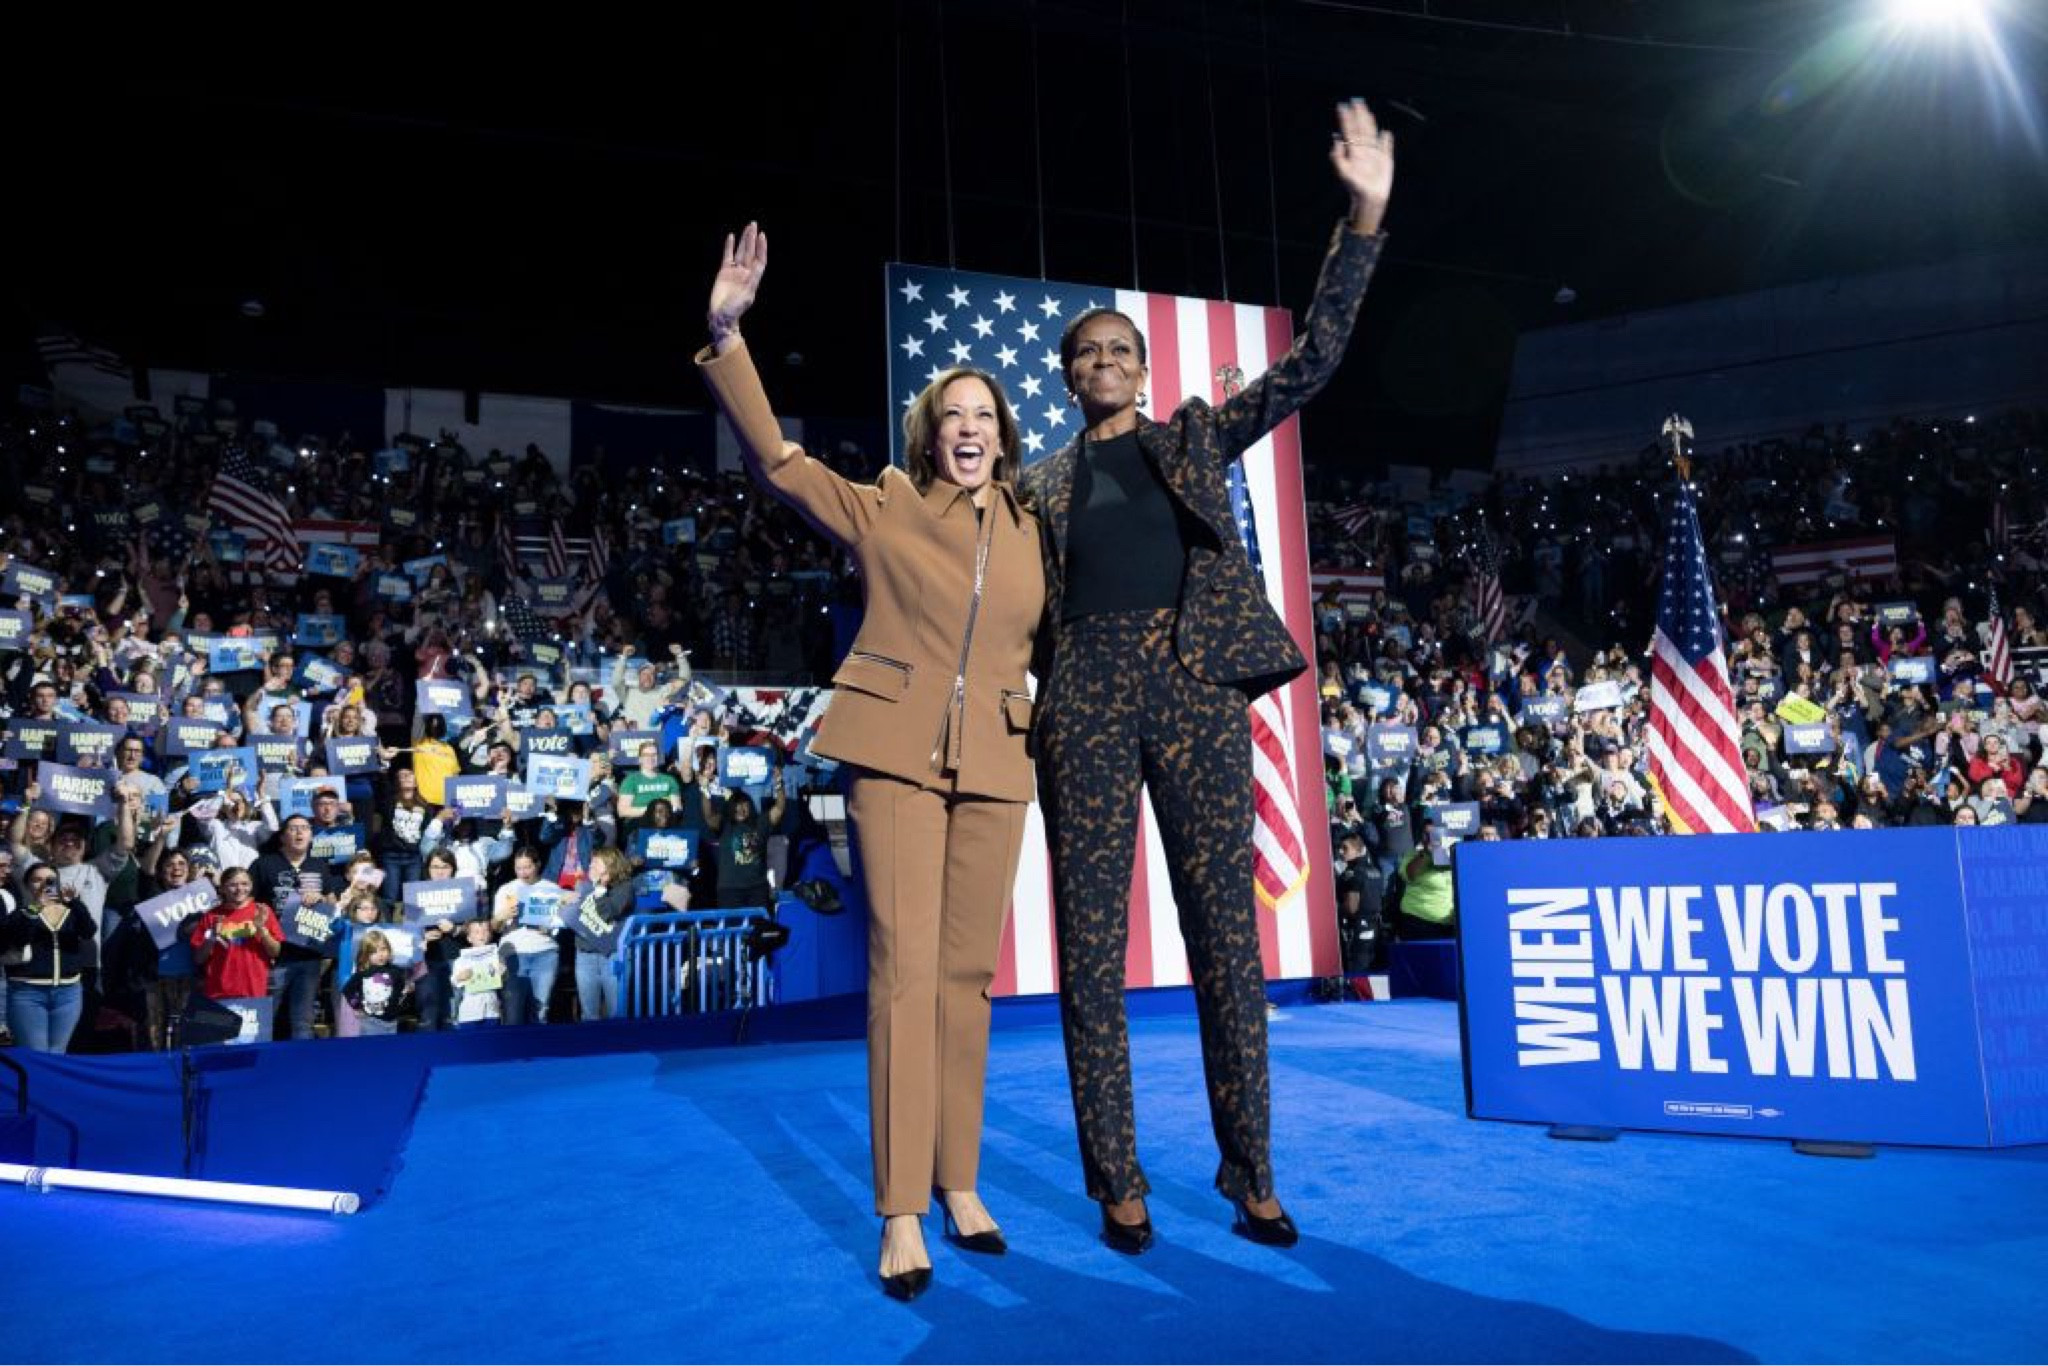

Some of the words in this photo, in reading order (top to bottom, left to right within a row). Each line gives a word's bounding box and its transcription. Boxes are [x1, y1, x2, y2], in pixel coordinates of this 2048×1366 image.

[526, 732, 569, 752] vote
[52, 774, 106, 797] HARRIS
[154, 891, 212, 928] vote
[1596, 886, 1709, 971] WE
[1716, 882, 1906, 973] VOTE
[1508, 888, 1601, 1067] WHEN
[1602, 976, 1729, 1074] WE
[1732, 977, 1917, 1082] WIN
